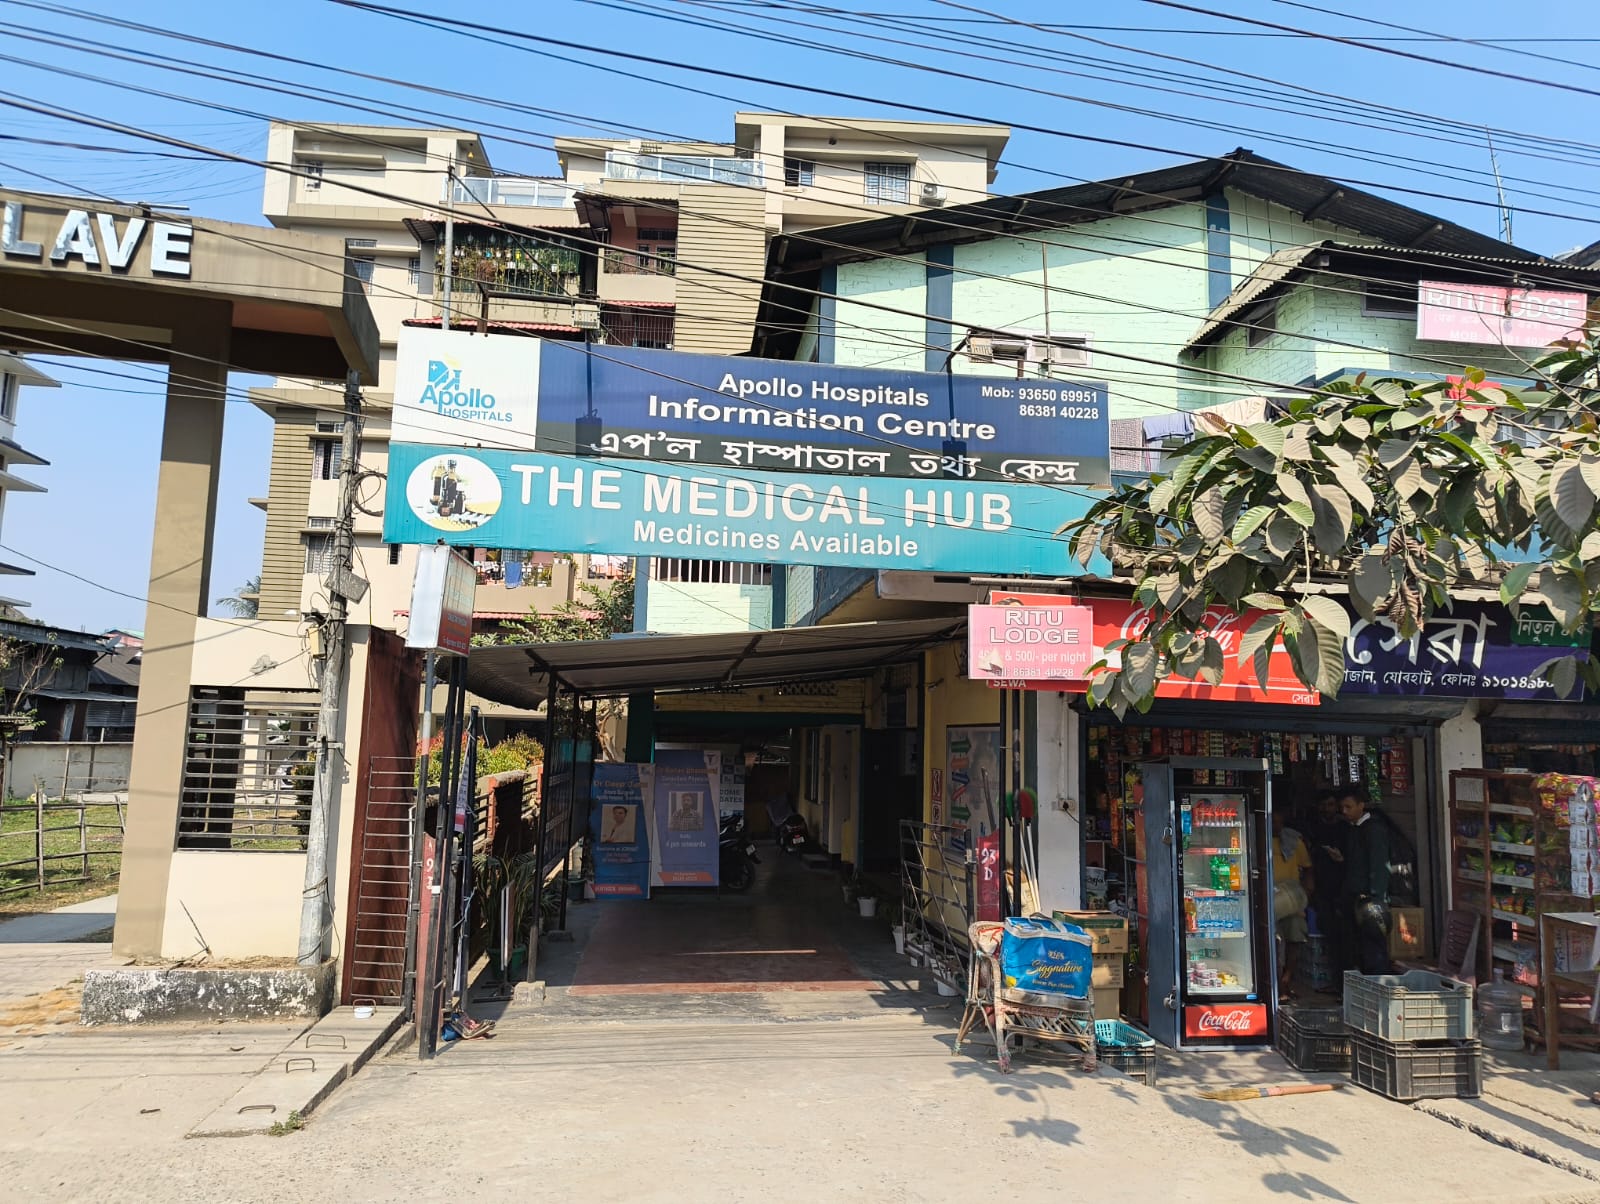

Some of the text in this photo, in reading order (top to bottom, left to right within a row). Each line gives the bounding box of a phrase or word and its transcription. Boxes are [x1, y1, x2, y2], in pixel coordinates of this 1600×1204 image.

[2, 200, 193, 275] LAVE
[419, 387, 496, 415] Apollo
[718, 373, 929, 408] Apollo Hospitals
[982, 386, 1098, 403] Mob: 93650 69951
[443, 407, 513, 423] HOSPITALS
[648, 395, 996, 440] Information Centre
[1019, 404, 1099, 419] 86381 40228
[908, 453, 982, 479] তথ্য
[510, 464, 1013, 532] THE MEDICAL HUB
[633, 520, 918, 557] Medicines Available
[1005, 609, 1063, 626] RITU
[989, 627, 1080, 645] LODGE
[1004, 649, 1013, 662] &
[1041, 652, 1058, 664] per
[1060, 651, 1086, 665] night
[1199, 1010, 1254, 1032] Coca-Cola
